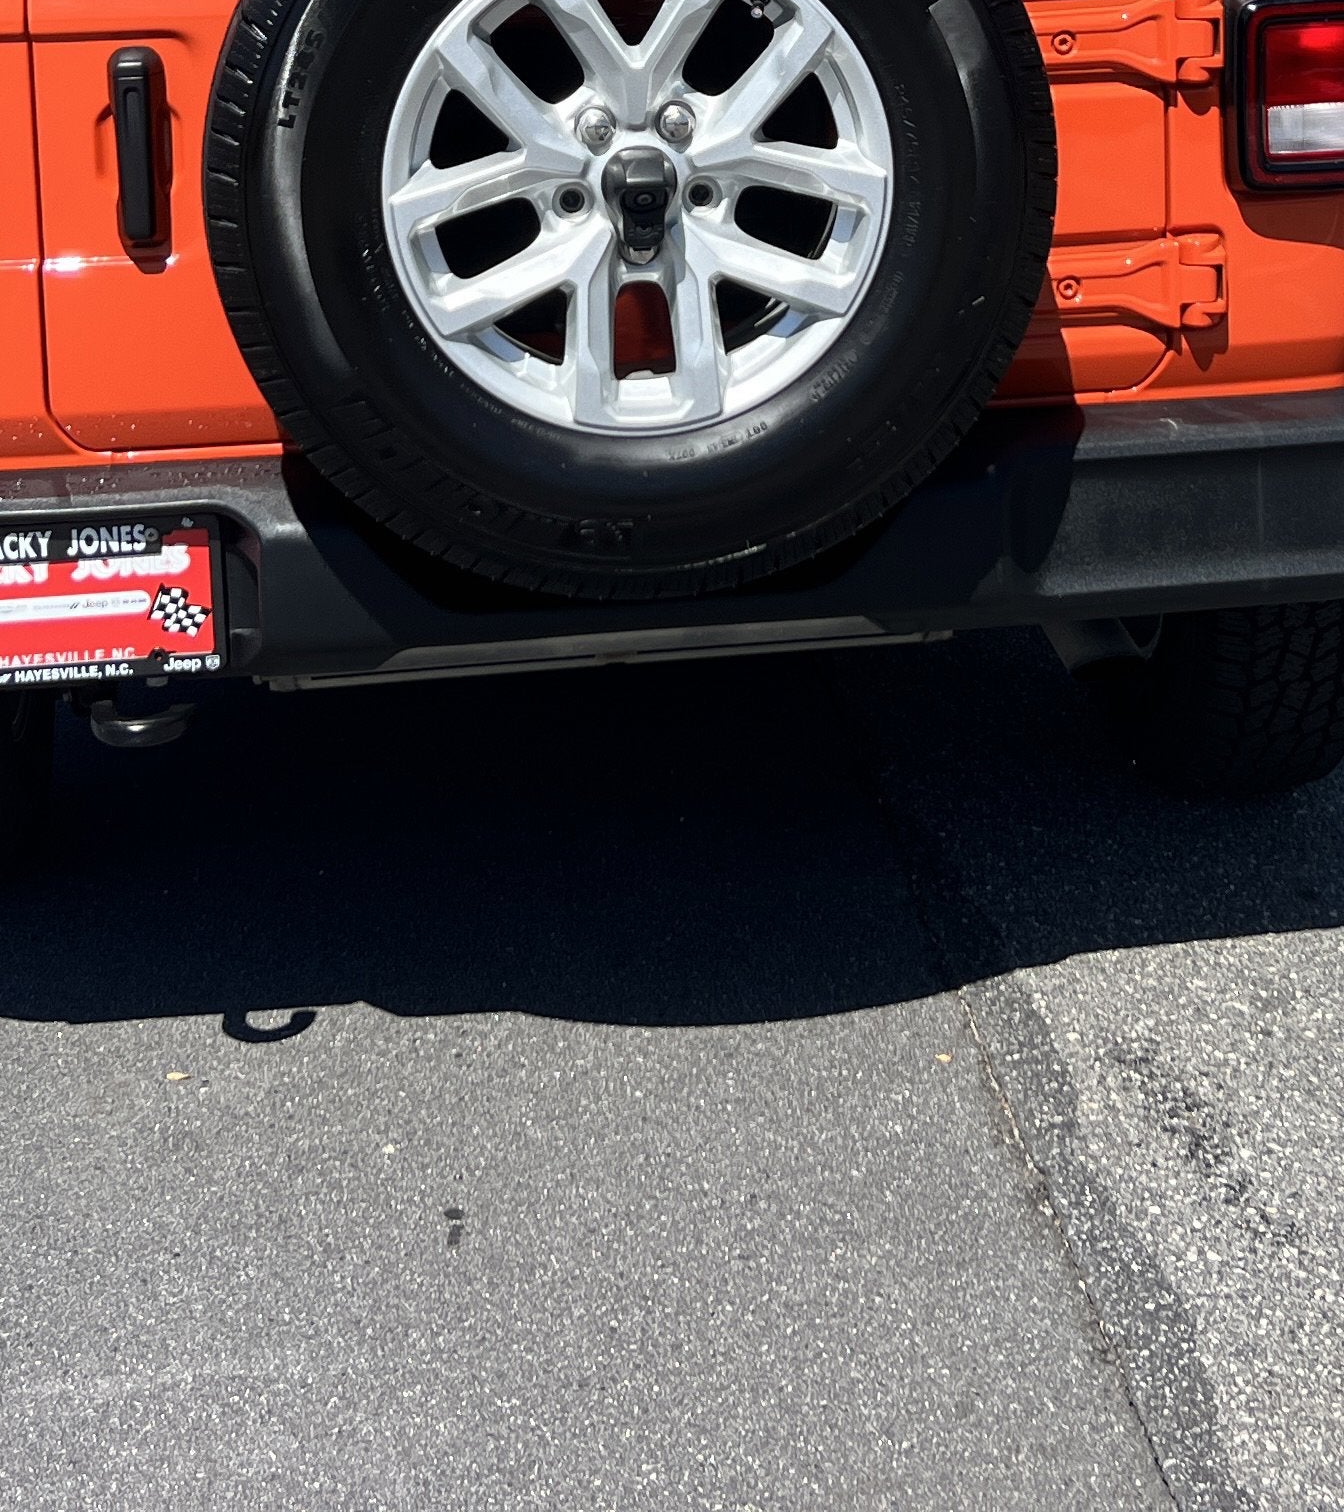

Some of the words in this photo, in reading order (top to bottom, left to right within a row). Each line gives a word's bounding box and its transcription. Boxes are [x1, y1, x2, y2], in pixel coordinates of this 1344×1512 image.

[67, 524, 146, 557] JONES
[14, 664, 102, 683] HAYESVILLE,
[105, 663, 134, 677] N.C.
[163, 655, 201, 672] Jeep
